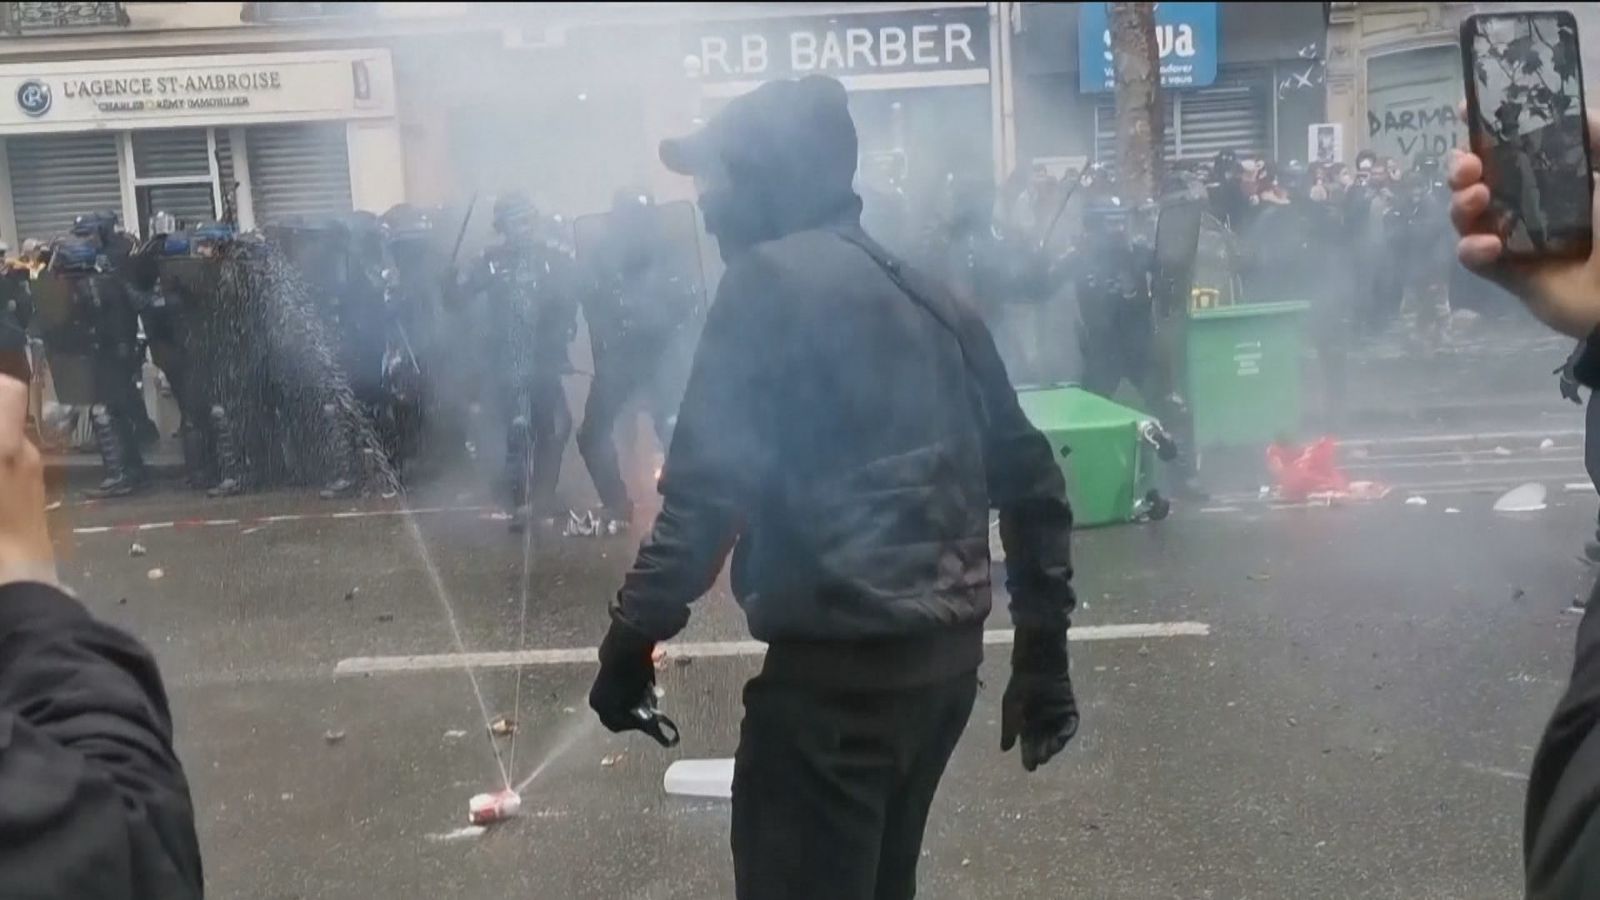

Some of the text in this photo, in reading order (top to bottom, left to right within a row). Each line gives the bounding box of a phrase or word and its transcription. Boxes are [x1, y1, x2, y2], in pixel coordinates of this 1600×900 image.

[701, 23, 976, 75] R.B BARBER
[63, 71, 281, 98] L'AGENCE ST-AMBROISE
